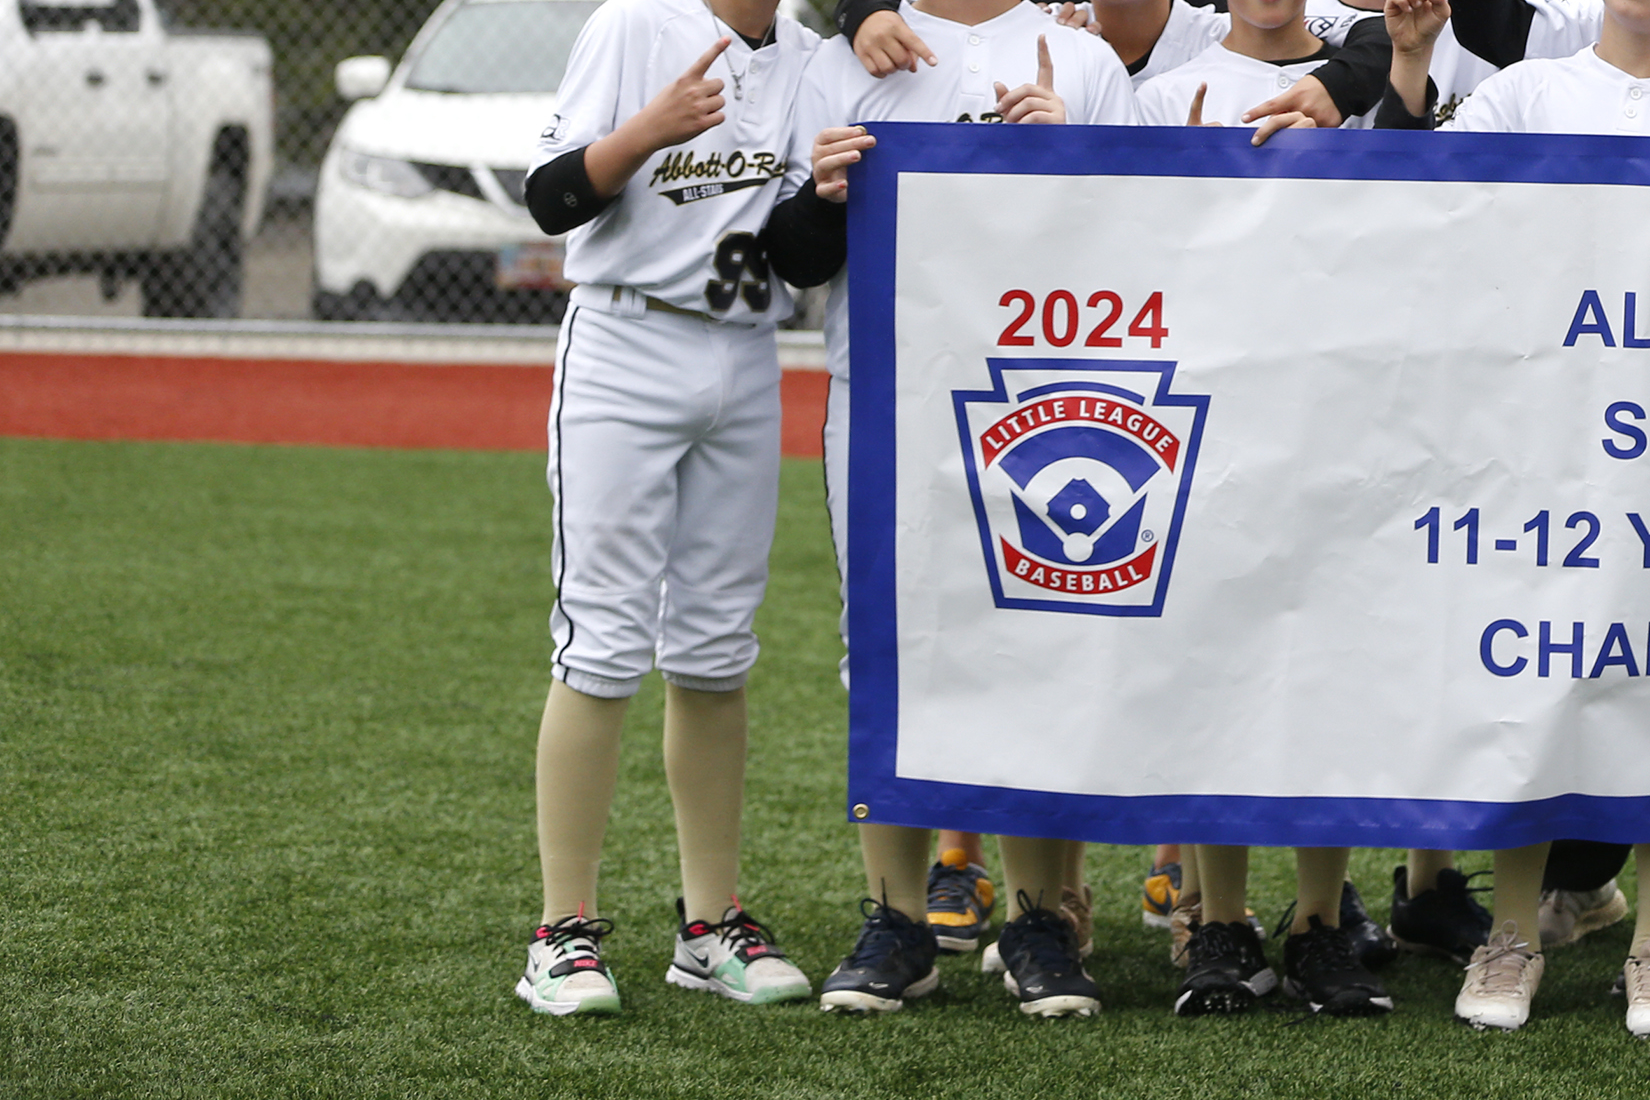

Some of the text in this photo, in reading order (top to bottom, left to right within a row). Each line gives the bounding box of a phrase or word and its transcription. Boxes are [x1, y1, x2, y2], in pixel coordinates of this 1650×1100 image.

[996, 288, 1169, 349] 2024
[985, 399, 1174, 454] LITTLE LEAGUE
[1413, 506, 1601, 569] 11-12
[1014, 557, 1144, 592] BASEBALL
